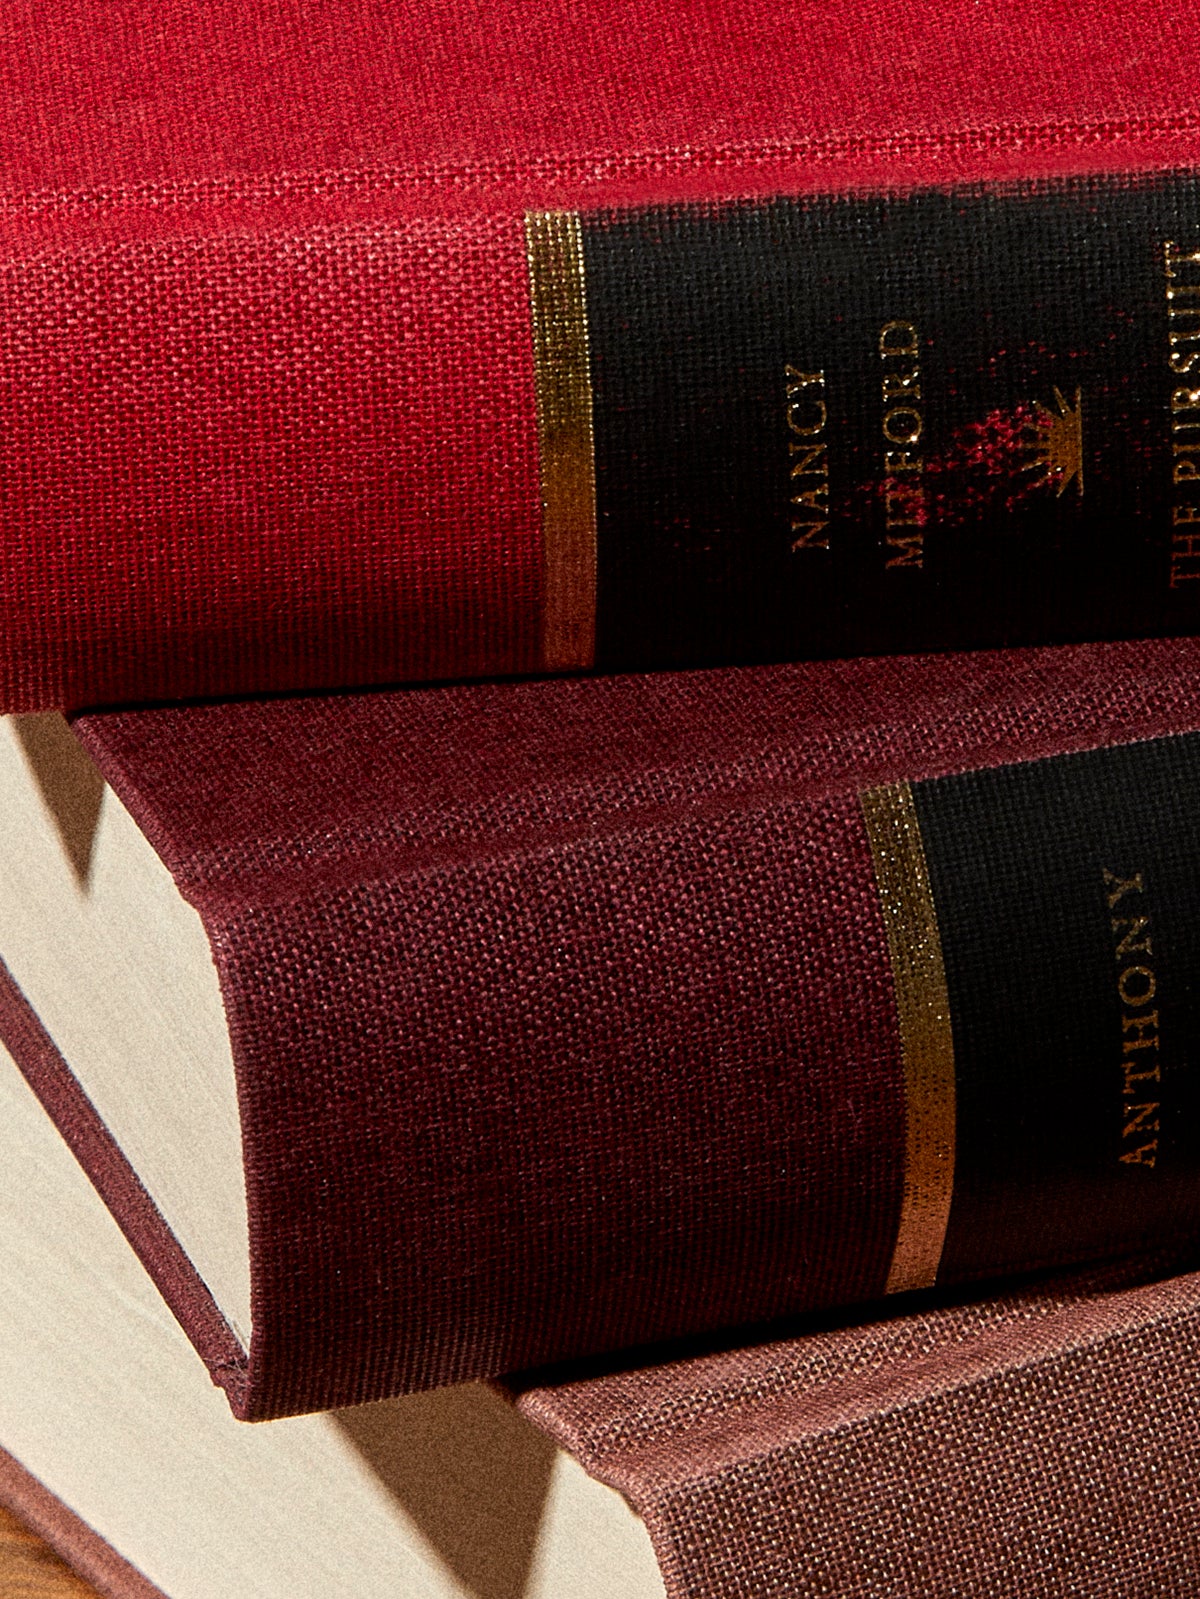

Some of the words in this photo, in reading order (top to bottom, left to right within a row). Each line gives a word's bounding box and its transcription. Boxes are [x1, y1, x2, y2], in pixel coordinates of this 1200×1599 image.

[784, 363, 830, 553] NANCY
[879, 319, 924, 570] MITFORD
[1103, 866, 1161, 1168] ANTHONY
